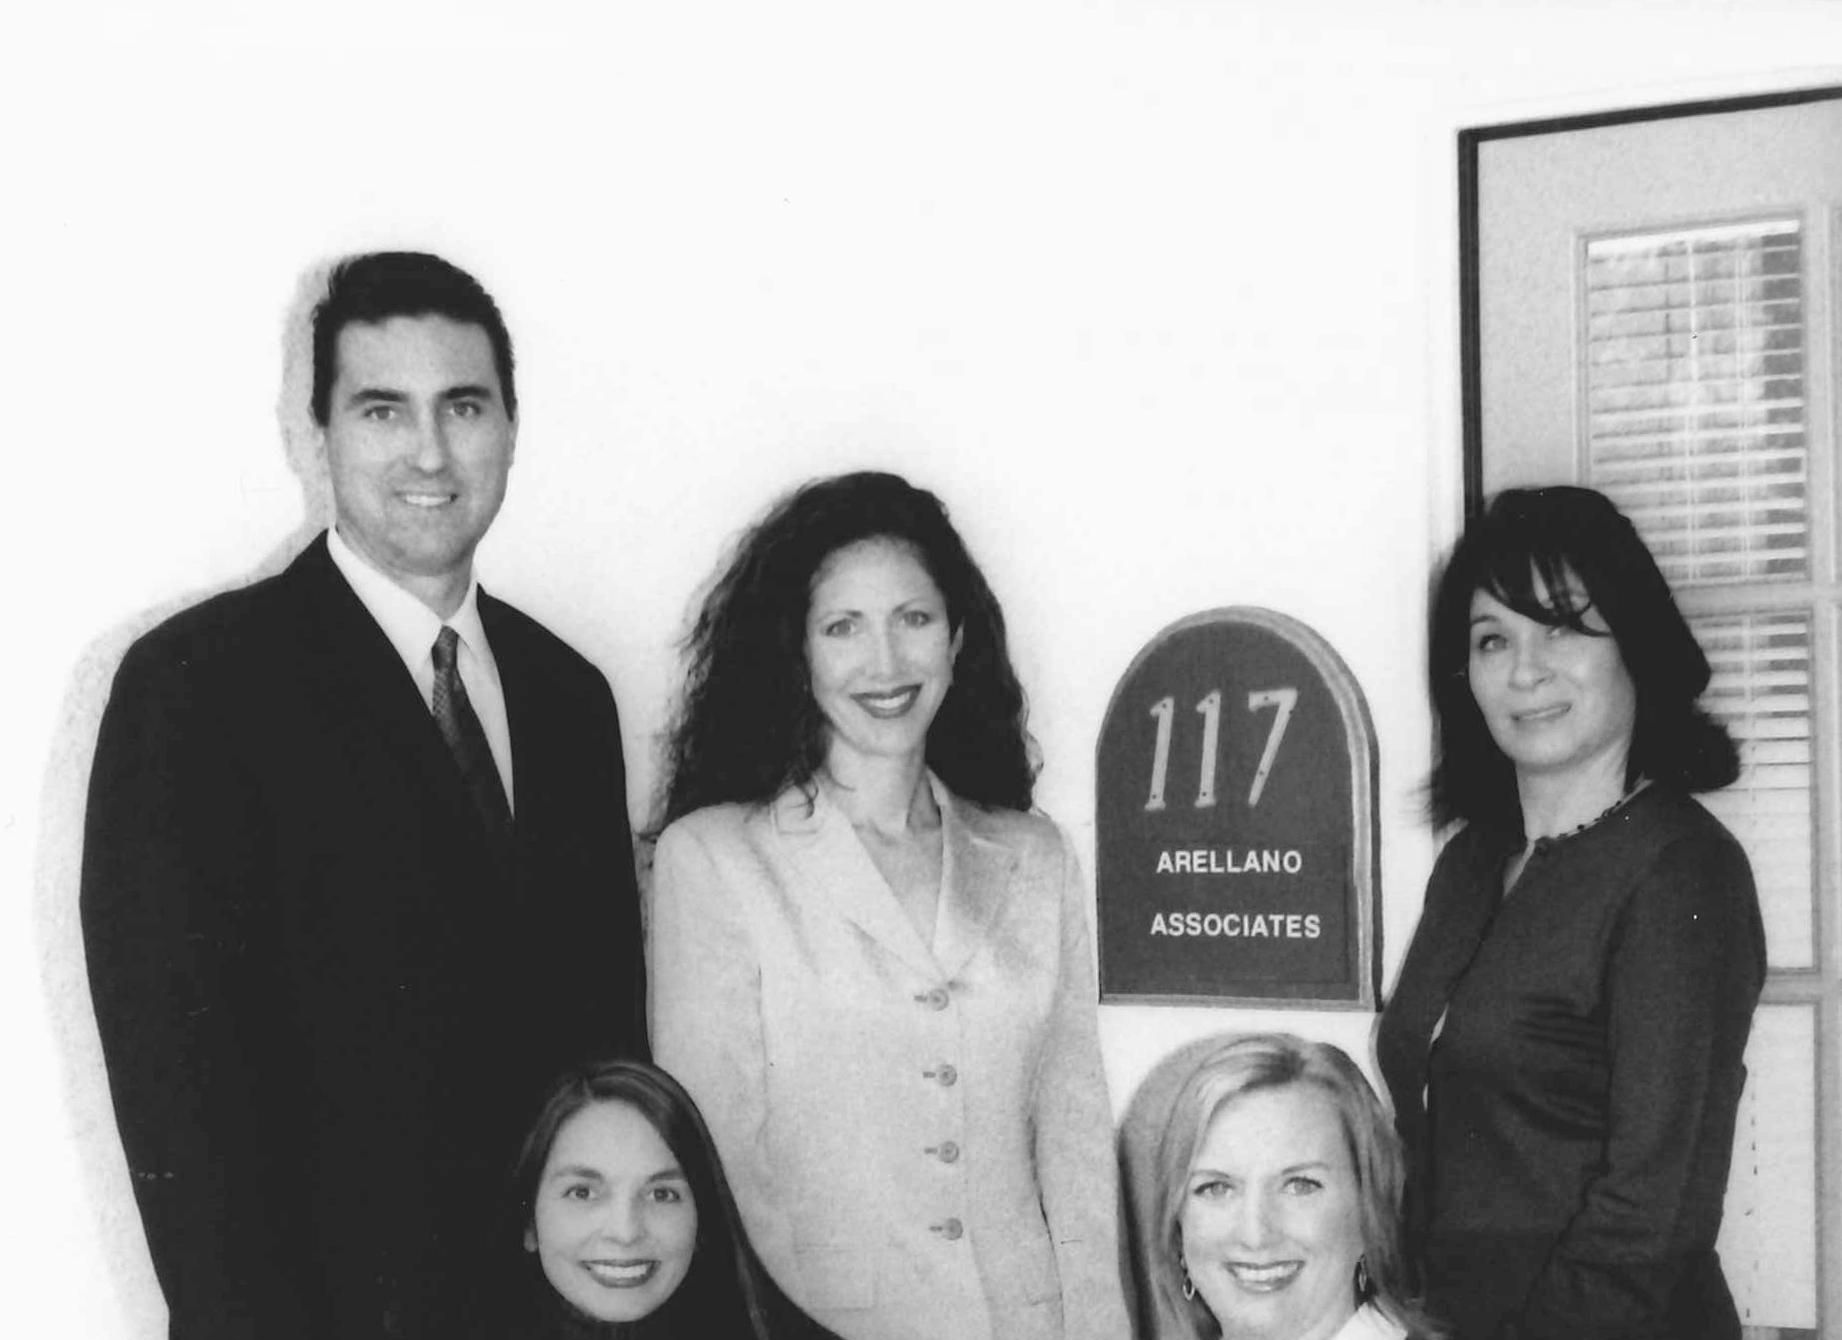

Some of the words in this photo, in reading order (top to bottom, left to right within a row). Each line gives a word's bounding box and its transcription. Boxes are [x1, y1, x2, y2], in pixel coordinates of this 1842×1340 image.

[1144, 687, 1299, 812] 117
[1156, 849, 1303, 875] ARELLANO
[1150, 911, 1322, 939] ASSOCIATES
